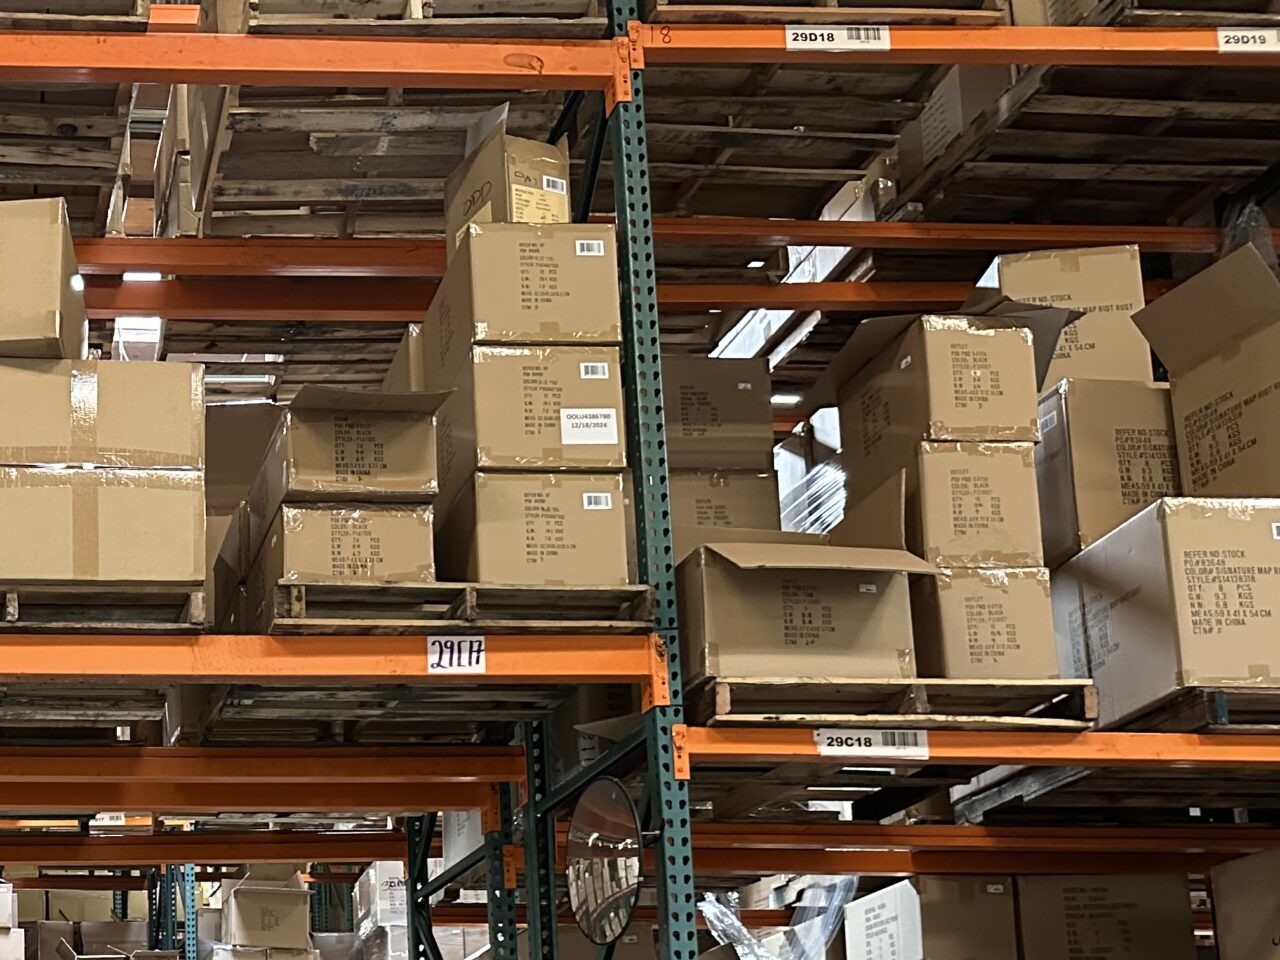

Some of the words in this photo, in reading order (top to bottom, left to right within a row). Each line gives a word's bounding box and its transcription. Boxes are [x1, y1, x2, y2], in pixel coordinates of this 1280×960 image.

[651, 26, 671, 44] 18
[792, 32, 835, 42] 29D18
[1224, 35, 1265, 44] 29D19
[826, 737, 872, 747] 29C18
